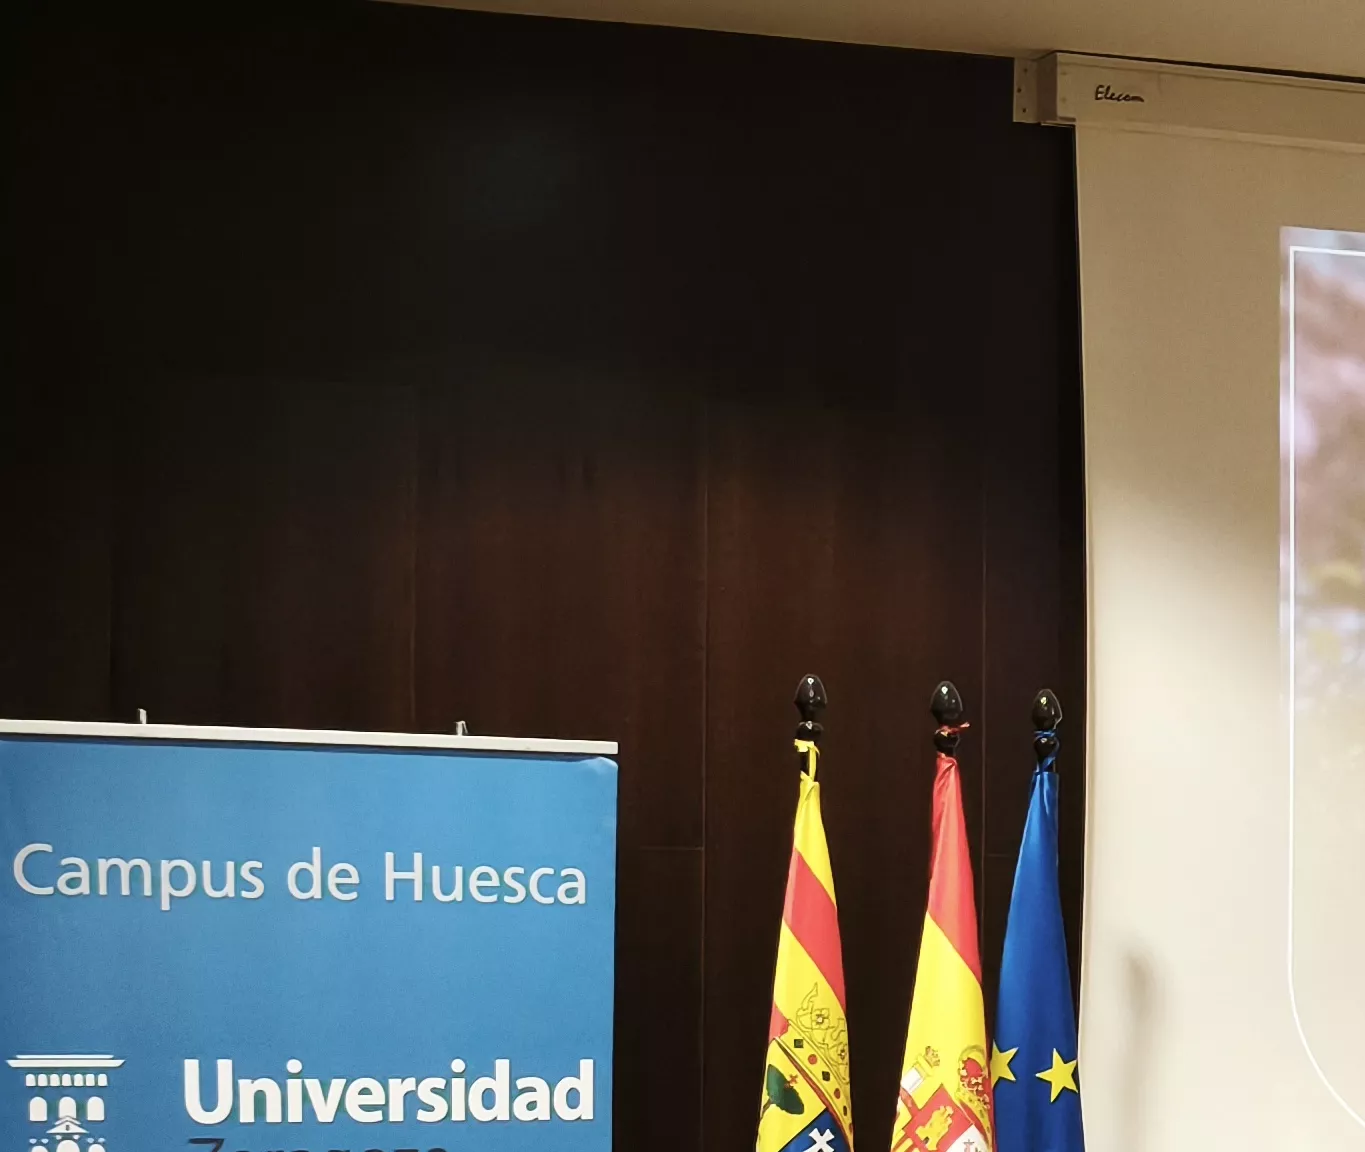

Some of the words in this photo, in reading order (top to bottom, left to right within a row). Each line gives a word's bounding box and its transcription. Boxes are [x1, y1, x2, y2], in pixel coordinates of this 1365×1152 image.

[12, 843, 265, 911] Campus
[287, 848, 360, 902] de
[384, 851, 588, 905] Huesca
[183, 1058, 594, 1125] Universidad
